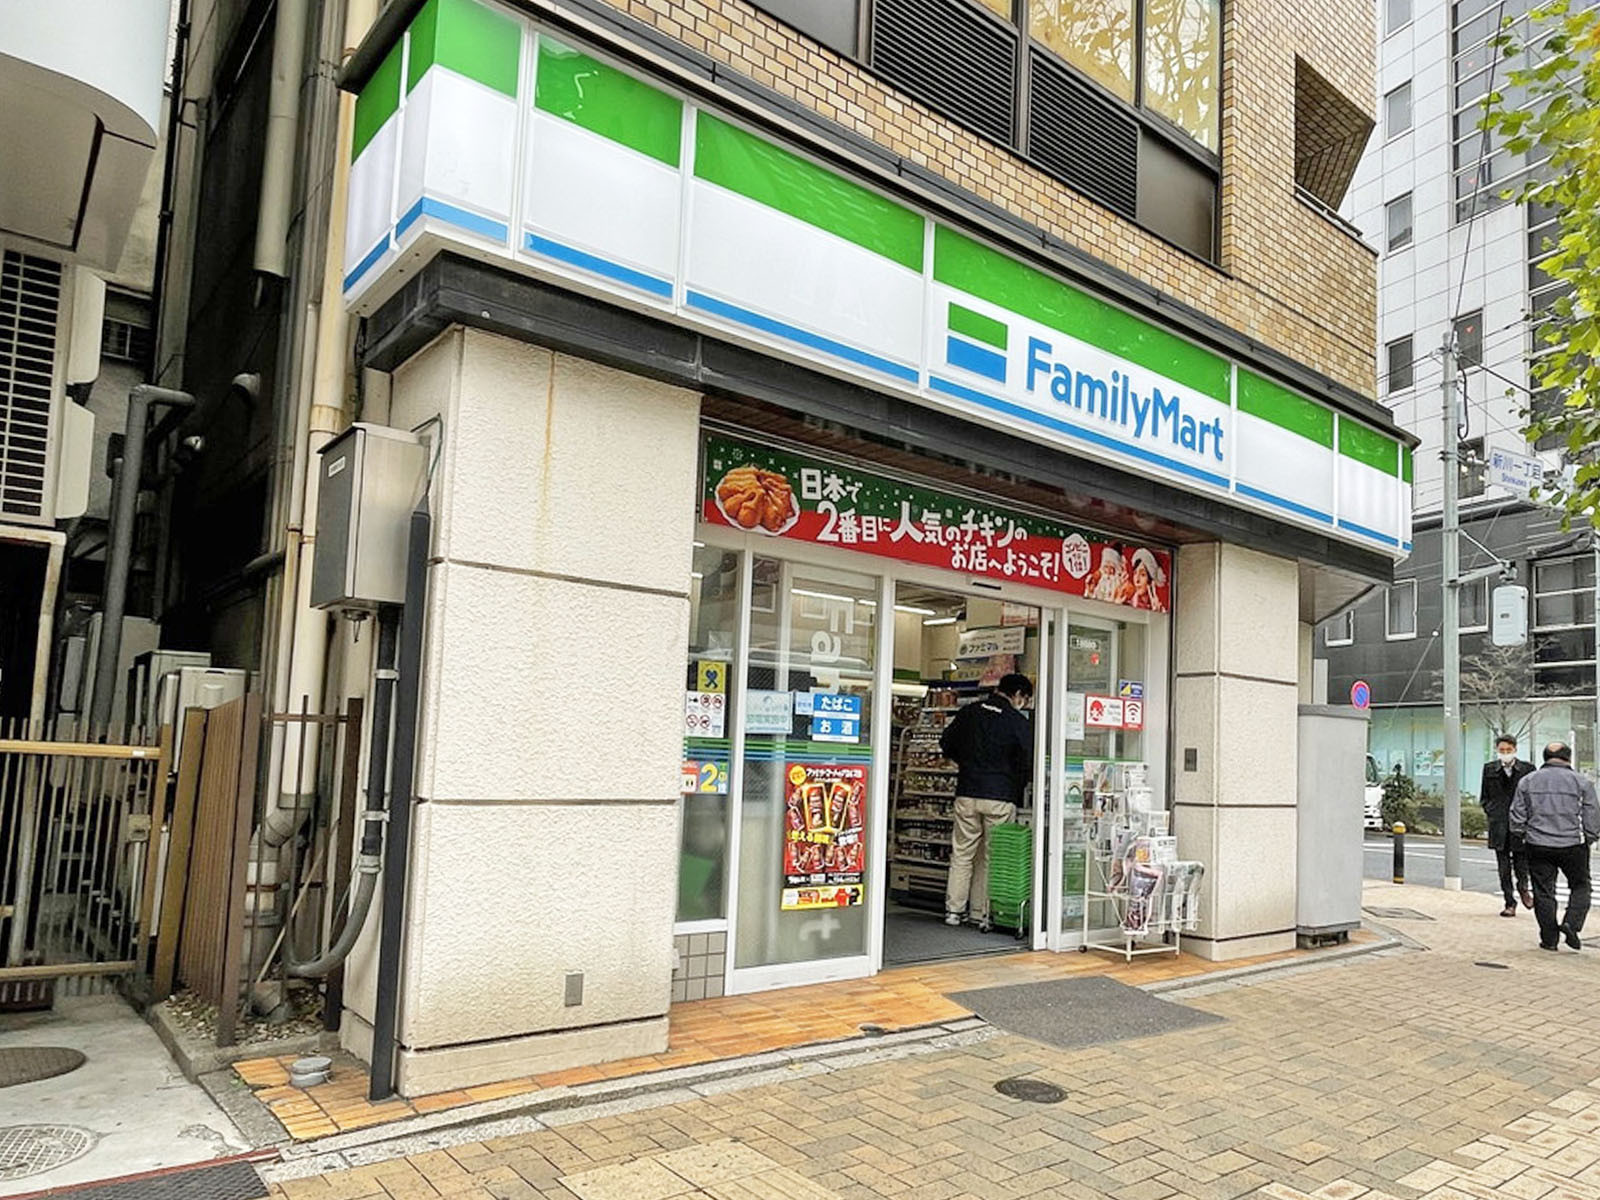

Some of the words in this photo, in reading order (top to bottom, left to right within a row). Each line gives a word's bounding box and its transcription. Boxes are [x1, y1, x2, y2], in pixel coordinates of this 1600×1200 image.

[1026, 335, 1224, 461] FamilyMart
[800, 467, 864, 504] 日本で
[820, 695, 854, 712] たばこ
